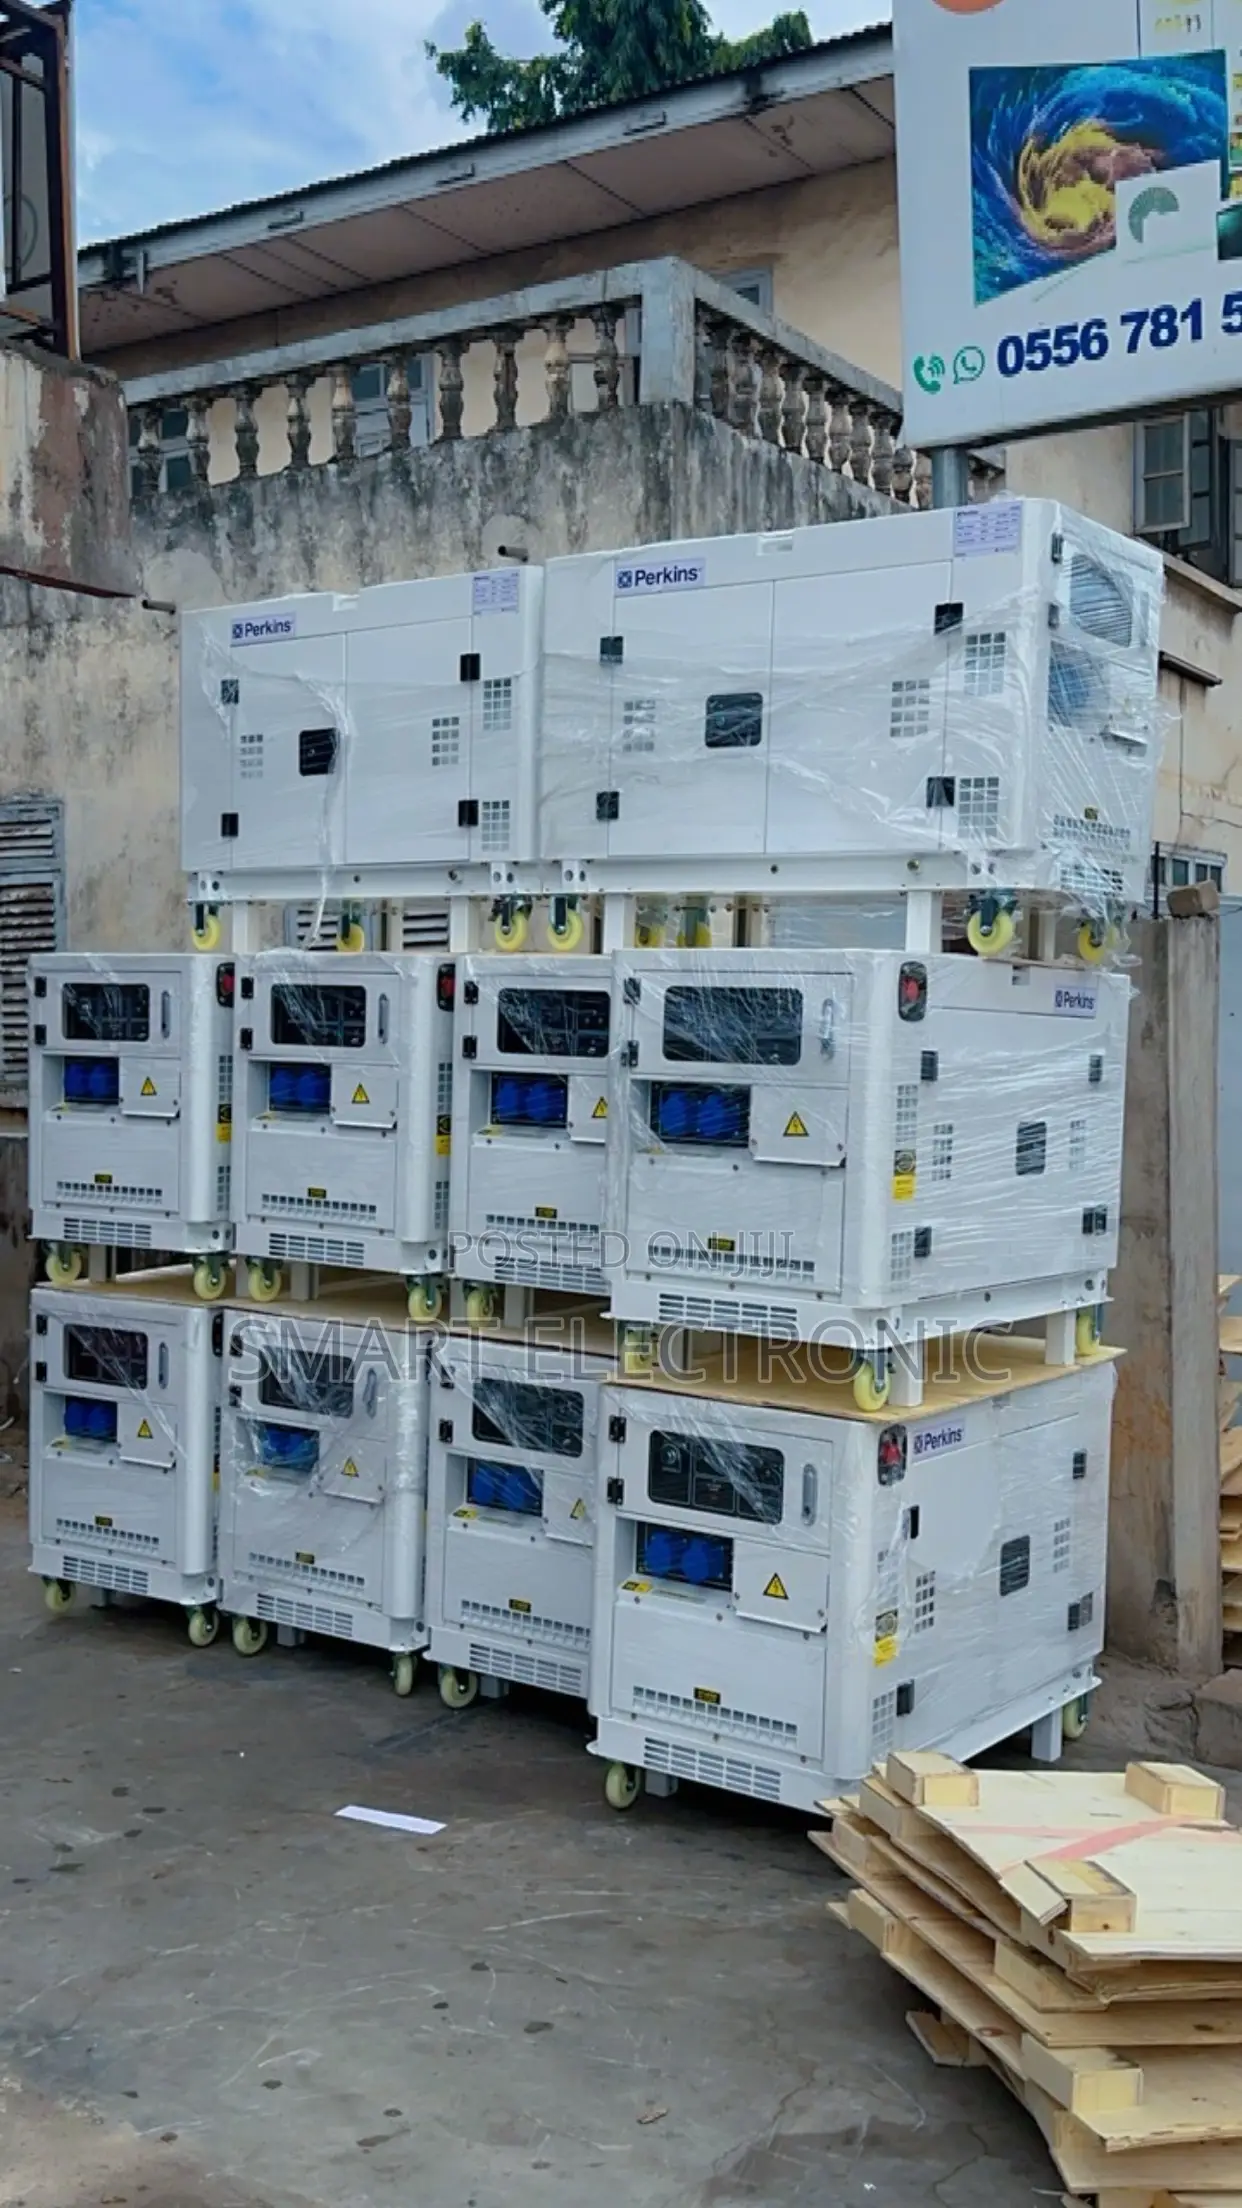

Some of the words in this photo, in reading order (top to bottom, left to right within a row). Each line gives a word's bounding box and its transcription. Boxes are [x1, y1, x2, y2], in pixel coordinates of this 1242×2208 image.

[997, 317, 1109, 377] 0556
[1120, 297, 1203, 354] 781
[634, 565, 699, 587] Perkins
[244, 619, 292, 637] Perkins
[924, 1427, 963, 1451] Perkins
